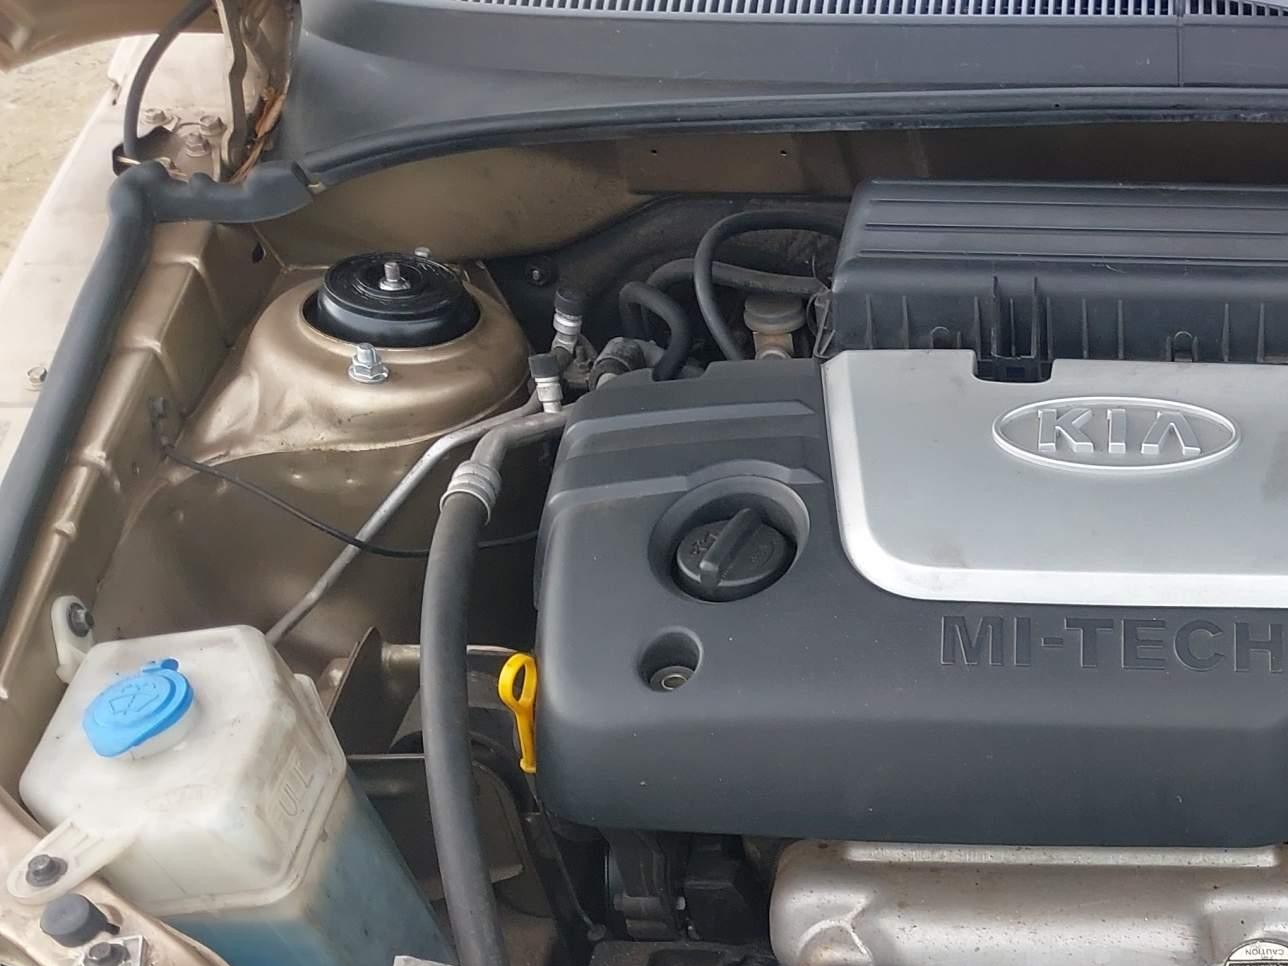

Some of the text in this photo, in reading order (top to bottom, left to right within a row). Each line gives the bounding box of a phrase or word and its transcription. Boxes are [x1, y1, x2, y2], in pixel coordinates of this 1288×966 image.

[1037, 408, 1201, 455] KIA
[939, 615, 1284, 674] MI-TECH
[1245, 947, 1285, 956] CAUTION
